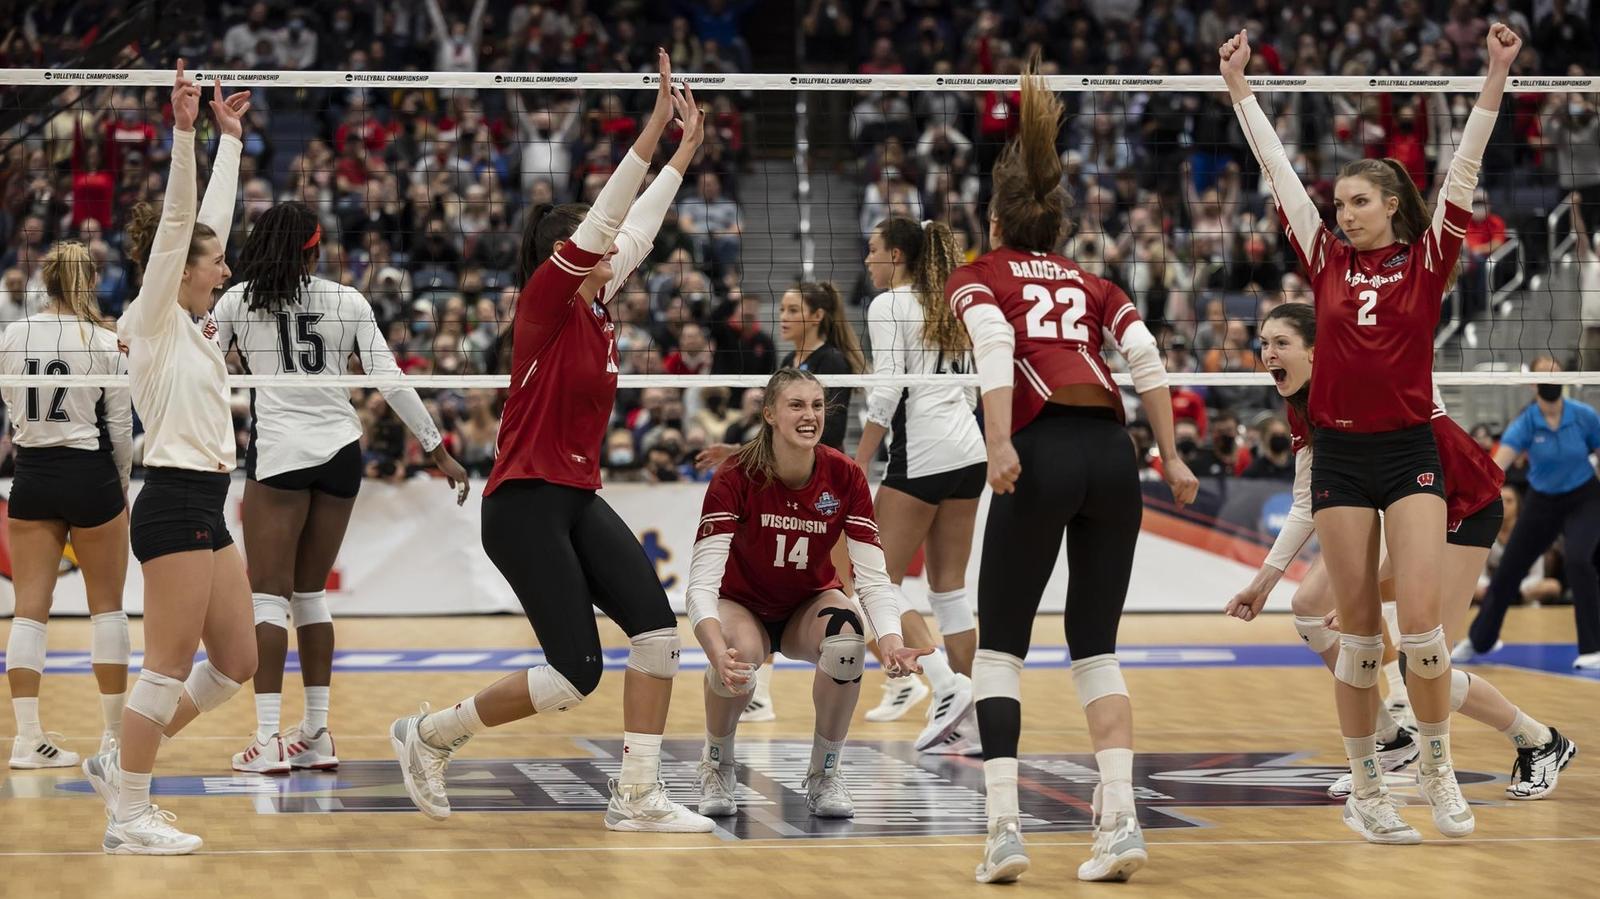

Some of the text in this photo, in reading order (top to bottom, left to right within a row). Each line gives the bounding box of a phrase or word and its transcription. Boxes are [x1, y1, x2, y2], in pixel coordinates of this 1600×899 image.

[1022, 283, 1089, 342] 22
[1357, 290, 1378, 326] 2
[272, 311, 327, 374] 15
[24, 358, 71, 422] 12
[760, 513, 827, 534] WISCONSIN
[773, 533, 810, 570] 14
